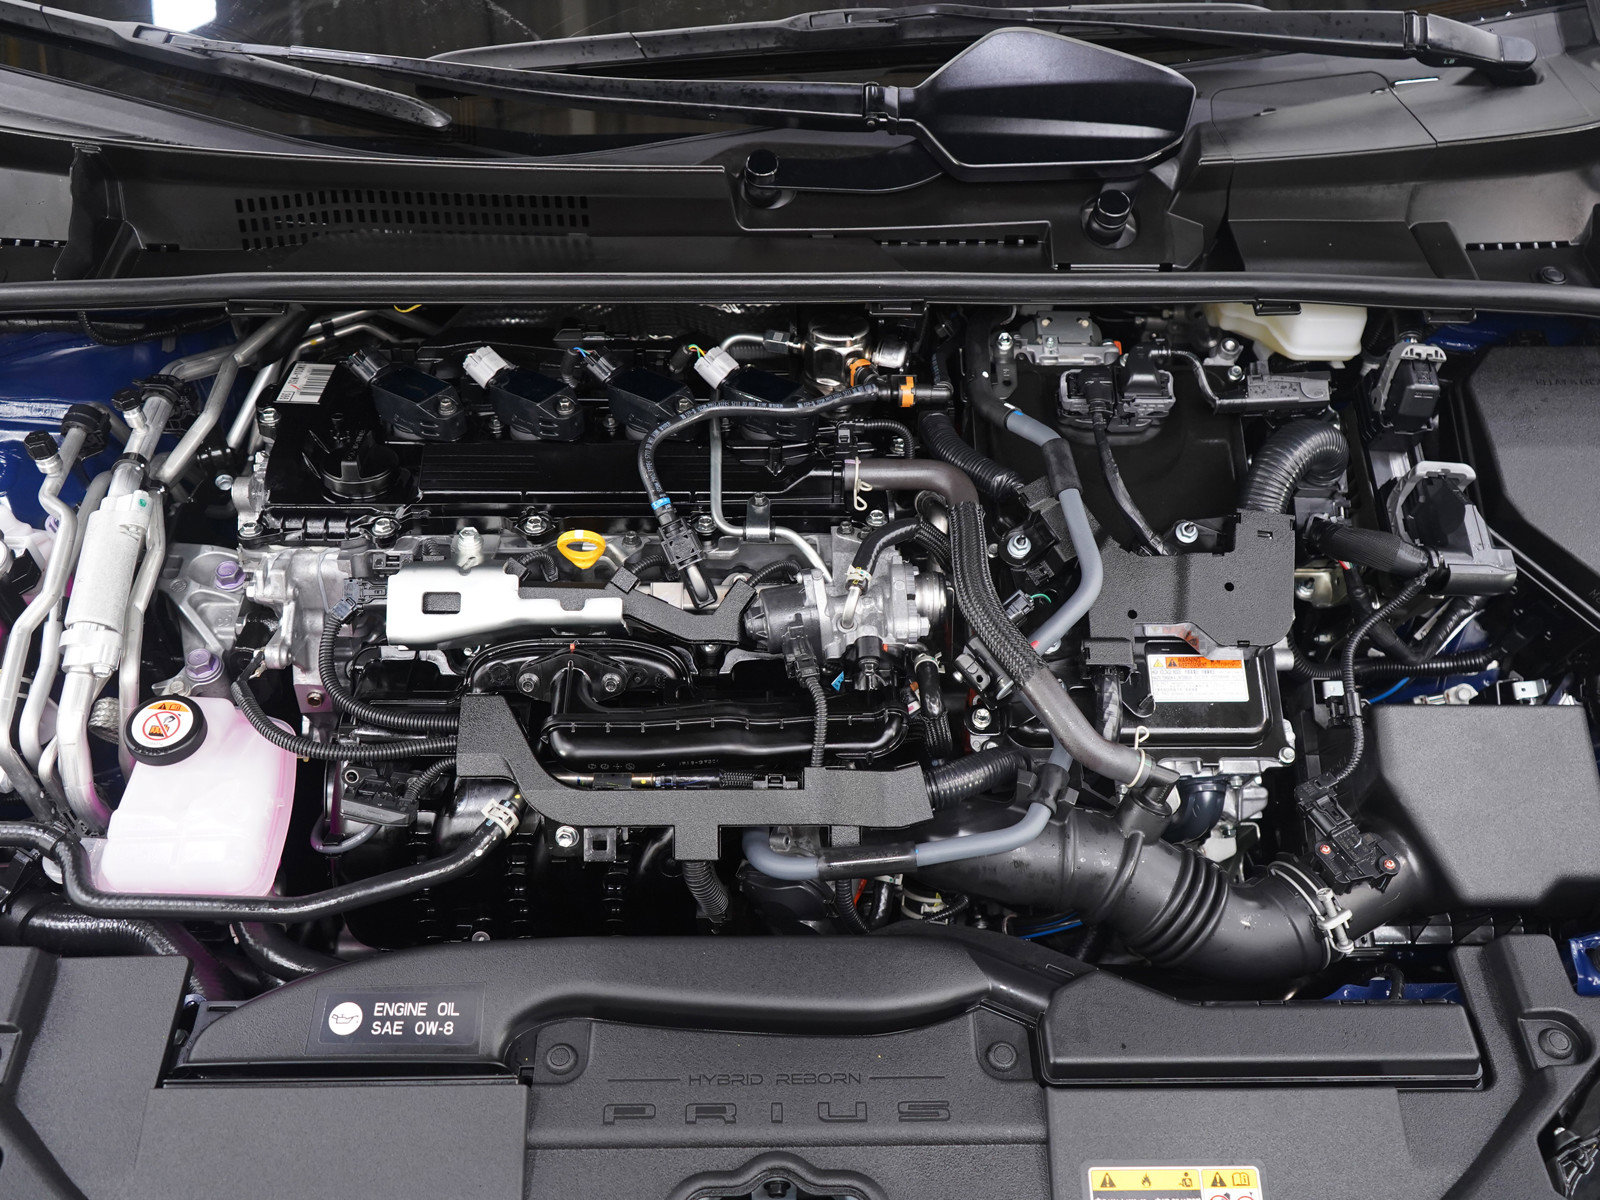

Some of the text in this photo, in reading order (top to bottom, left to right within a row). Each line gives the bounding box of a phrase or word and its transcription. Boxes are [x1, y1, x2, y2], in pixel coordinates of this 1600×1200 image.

[373, 1002, 460, 1016] ENGINE OIL
[371, 1021, 404, 1035] SAE
[688, 1072, 862, 1087] HYBRID REBORN
[602, 1101, 951, 1125] PRIUS
